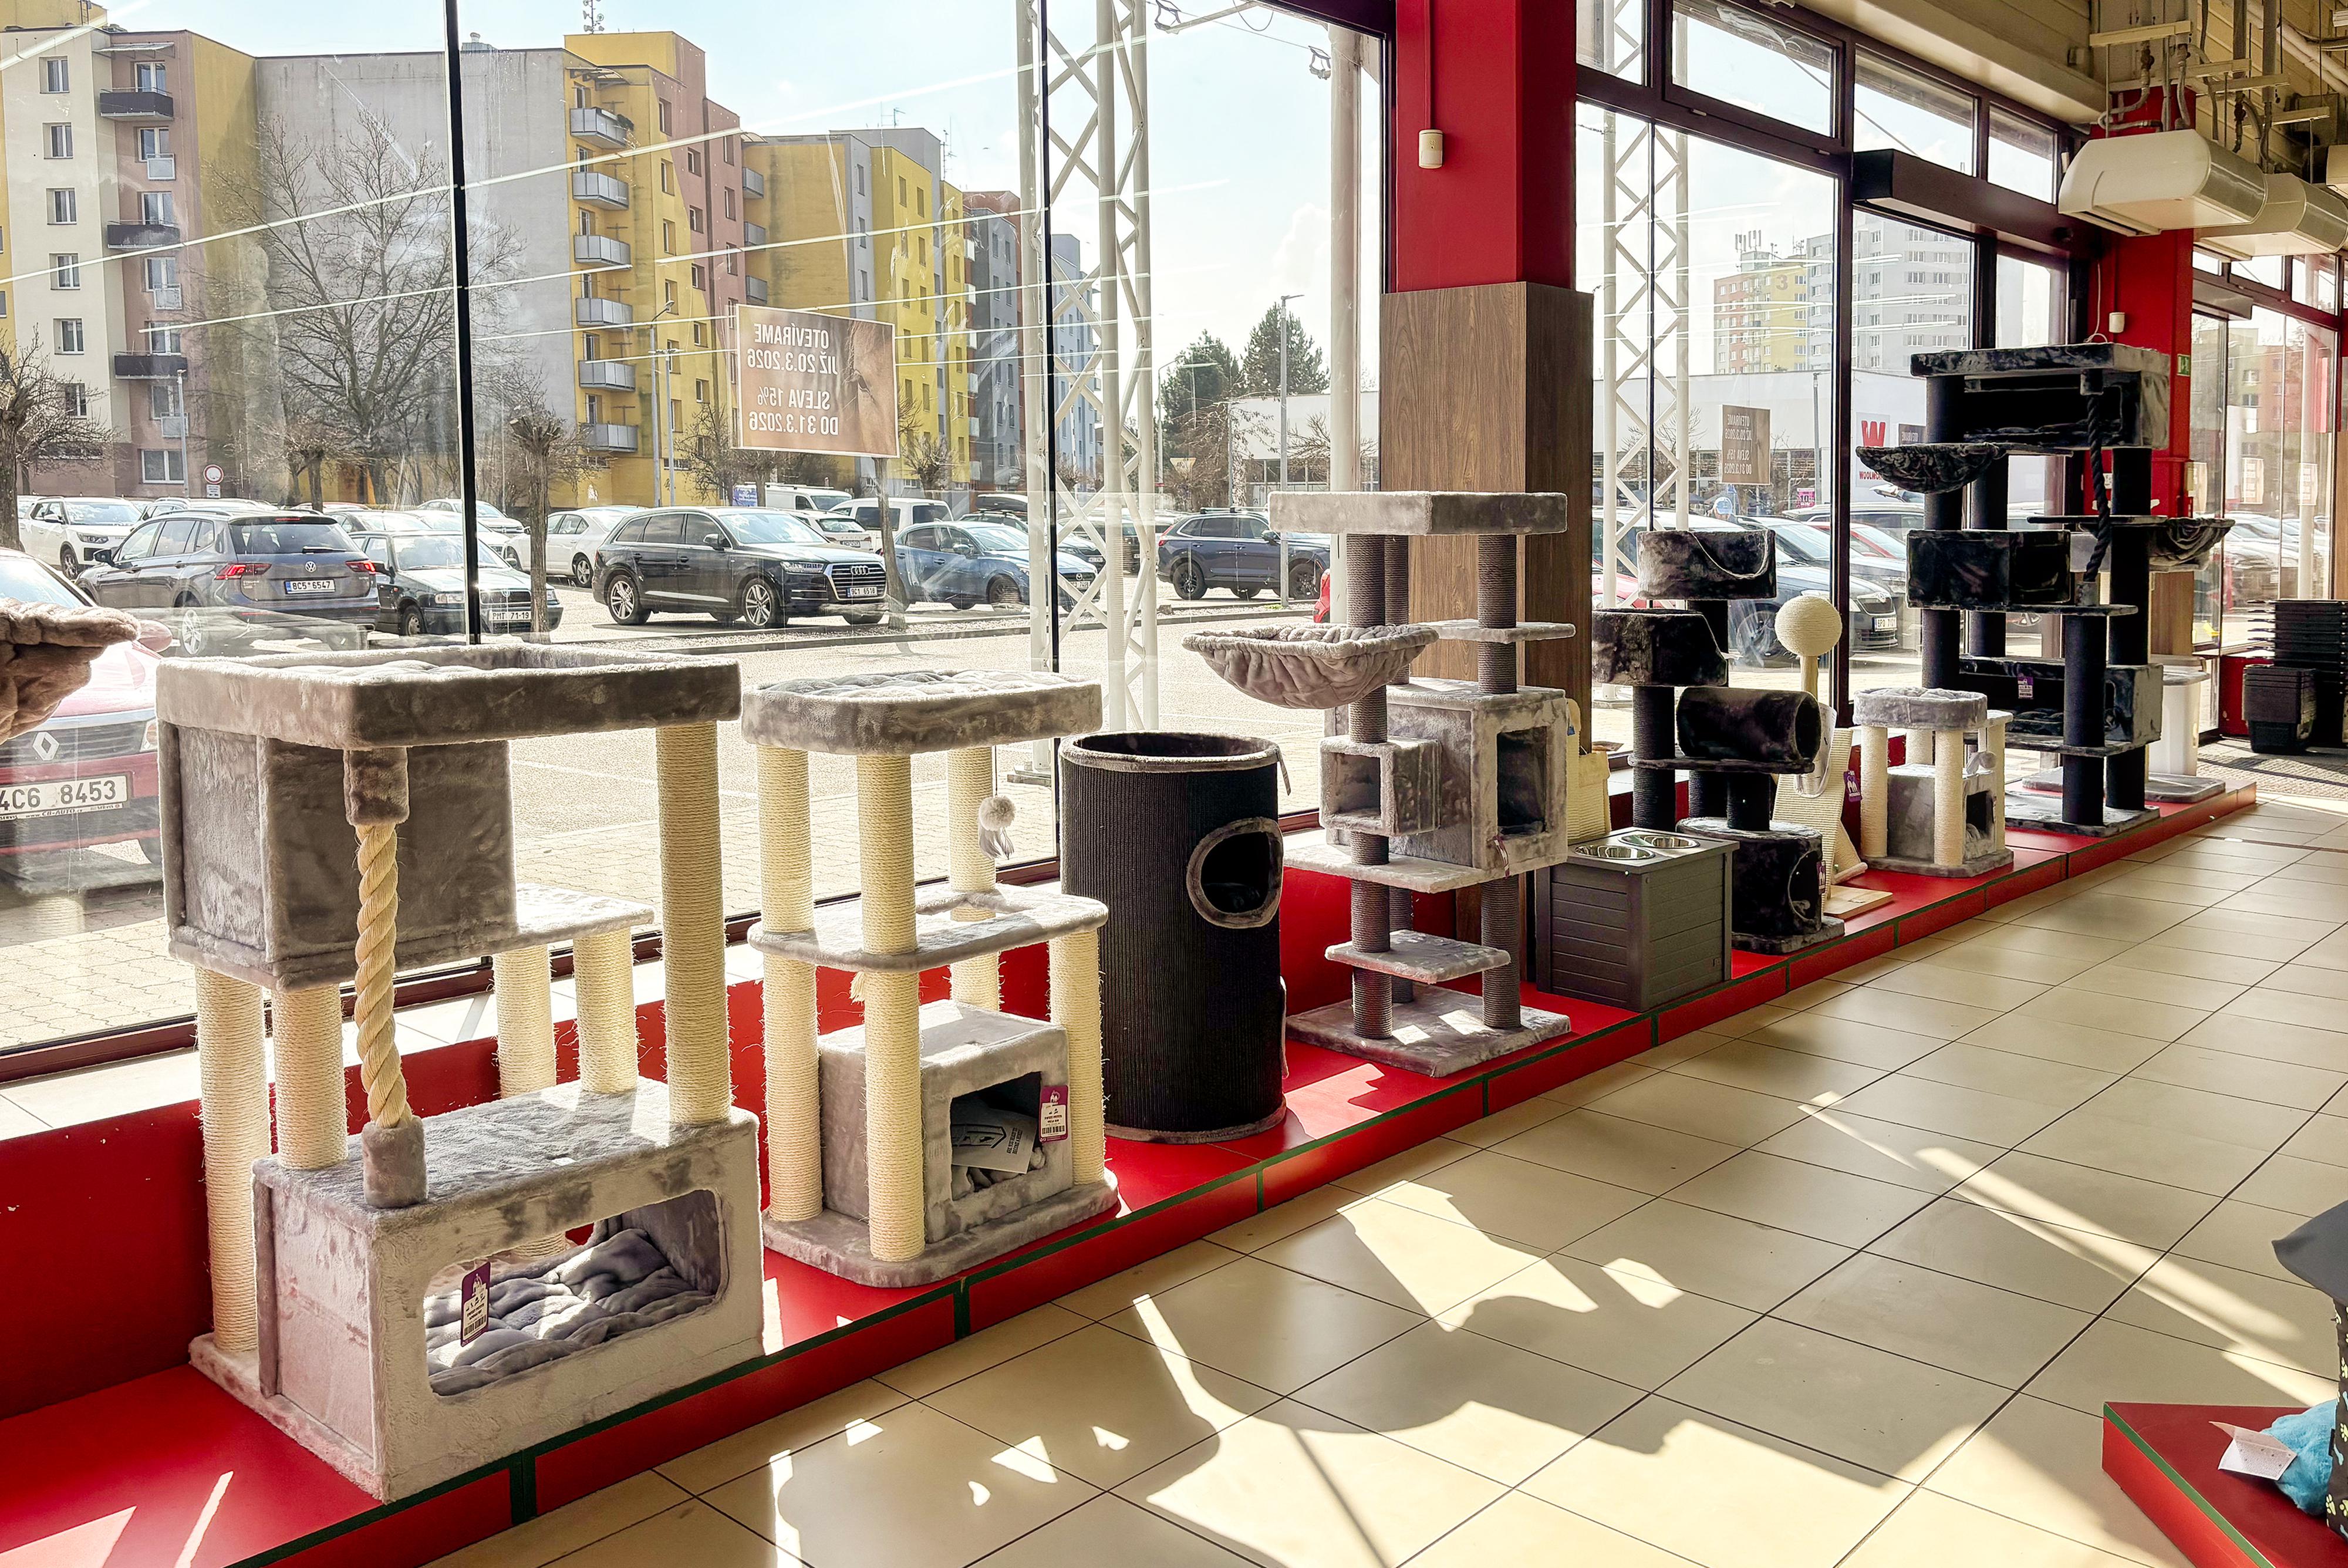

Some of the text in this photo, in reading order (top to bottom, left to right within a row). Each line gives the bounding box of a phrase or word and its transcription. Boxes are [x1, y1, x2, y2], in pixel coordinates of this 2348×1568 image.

[1776, 275, 1789, 291] 3
[312, 581, 331, 589] 6547
[0, 780, 116, 811] 4C6 8453
